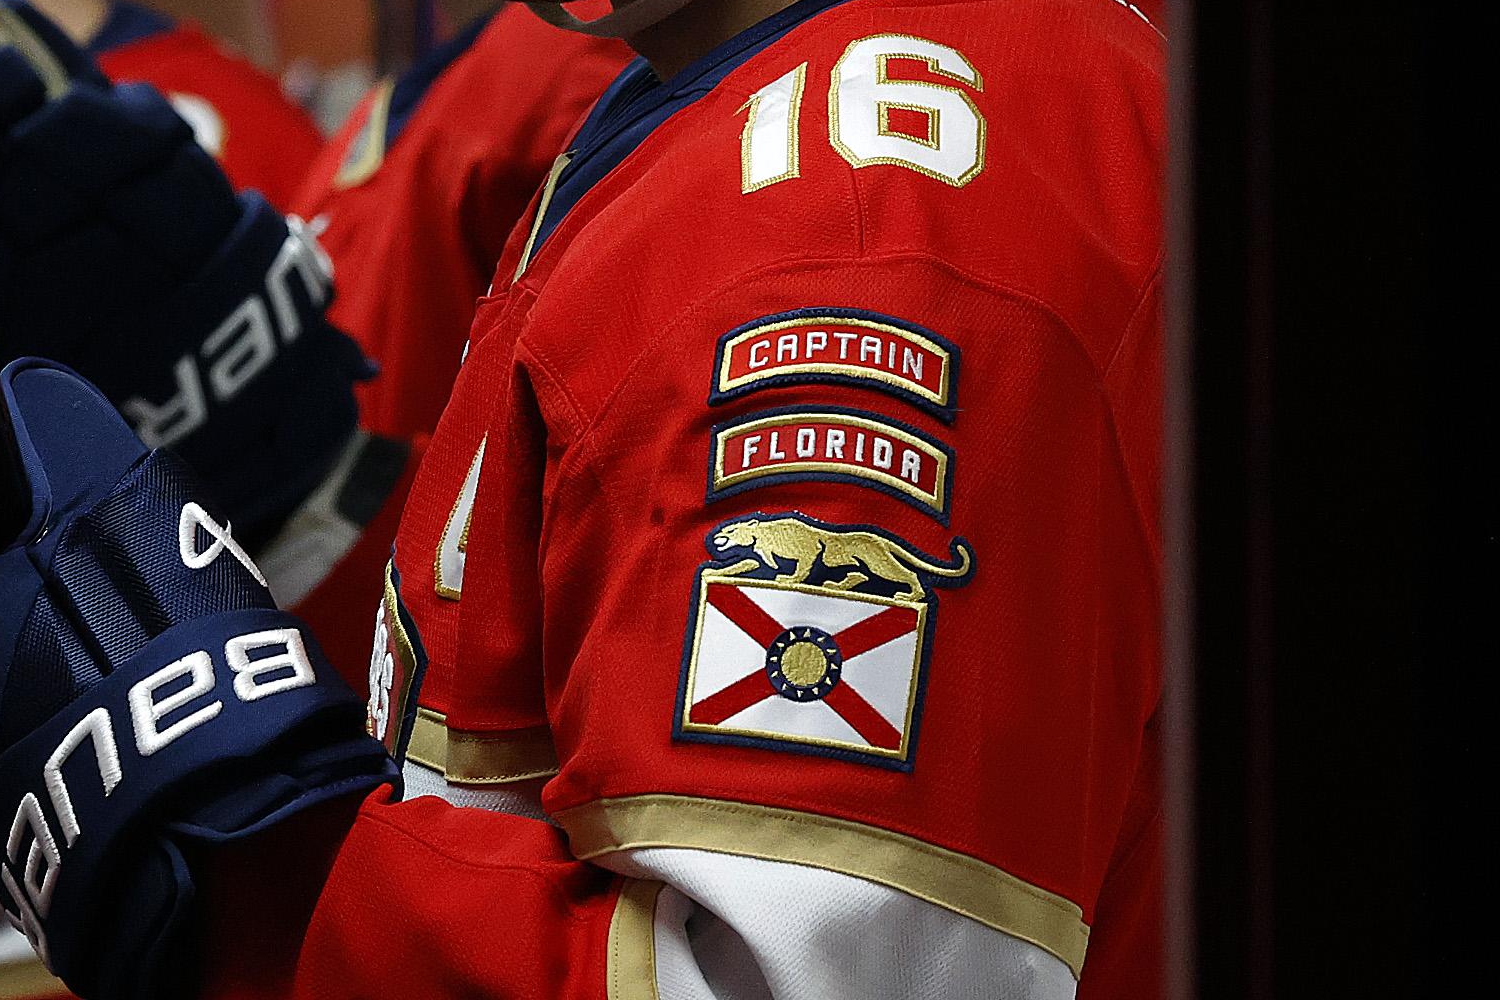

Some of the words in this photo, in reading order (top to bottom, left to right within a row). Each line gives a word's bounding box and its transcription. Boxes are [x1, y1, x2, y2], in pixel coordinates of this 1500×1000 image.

[734, 32, 987, 194] 16
[748, 330, 924, 381] CAPTAIN
[741, 427, 922, 485] FLORIDA
